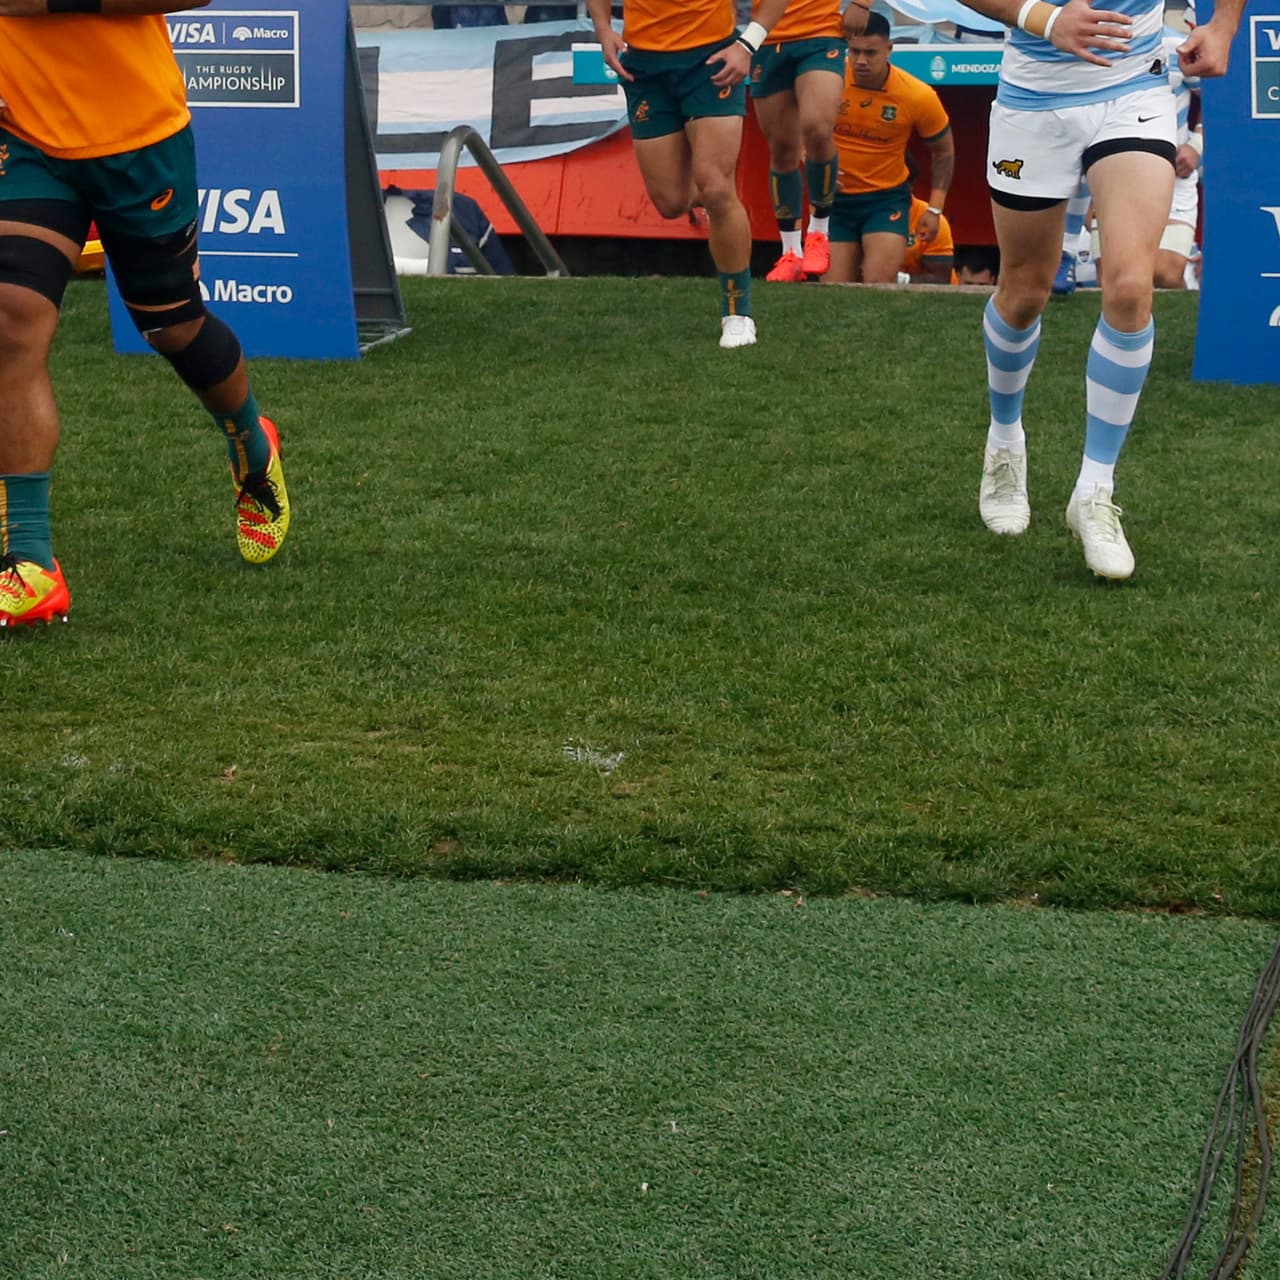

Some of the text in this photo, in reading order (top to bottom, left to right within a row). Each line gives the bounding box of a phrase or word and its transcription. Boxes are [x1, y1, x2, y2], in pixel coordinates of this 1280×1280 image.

[253, 27, 289, 39] Macro
[183, 63, 285, 91] AMPIONSHIP
[196, 65, 252, 74] THE RUGBY
[214, 280, 293, 303] Macro
